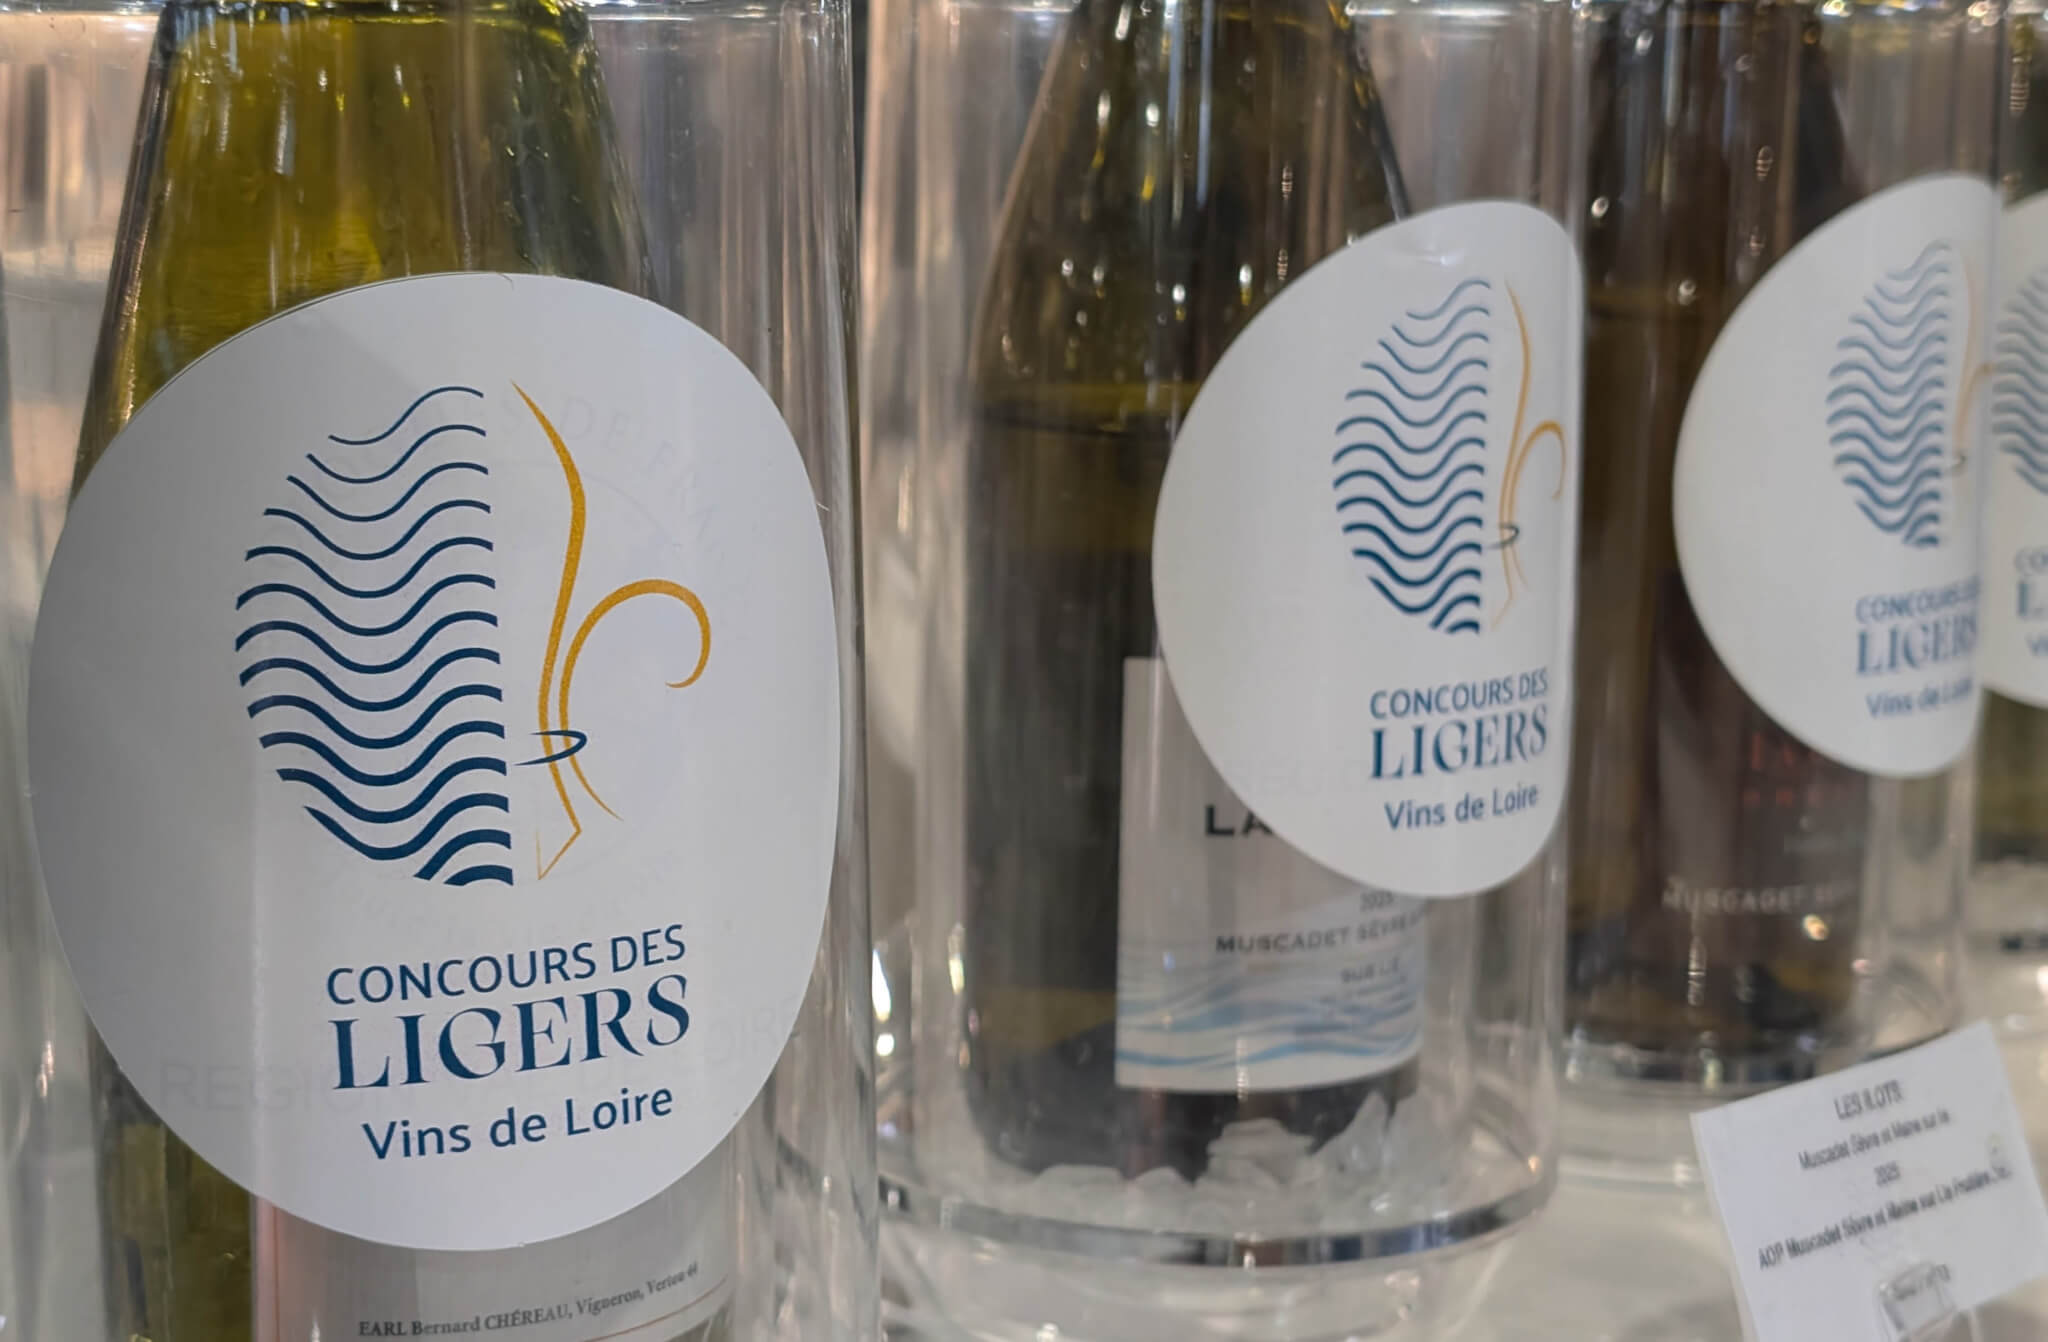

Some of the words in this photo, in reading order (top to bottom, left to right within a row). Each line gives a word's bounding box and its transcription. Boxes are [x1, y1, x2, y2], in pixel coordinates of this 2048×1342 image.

[1369, 675, 1513, 720] CONCOURS
[1518, 665, 1548, 700] DES
[1369, 703, 1548, 780] LIGERS
[1384, 798, 1446, 831] Vins
[1454, 792, 1485, 823] de
[1491, 780, 1539, 817] Loire
[326, 941, 597, 1006] CONCOURS
[610, 923, 686, 974] DES
[1214, 925, 1350, 954] MUSCADET
[327, 973, 690, 1091] LIGERS
[361, 1119, 472, 1161] Vins
[489, 1106, 548, 1148] de
[565, 1087, 674, 1137] Loire
[1833, 1091, 1863, 1120] LES
[1757, 1243, 1784, 1270] AOP
[1785, 1224, 1842, 1259] Muscadet
[358, 1320, 407, 1337] EARL
[411, 1314, 481, 1336] Bernard
[484, 1302, 574, 1331] CHÉREAU,
[575, 1287, 645, 1316] Vigneron,
